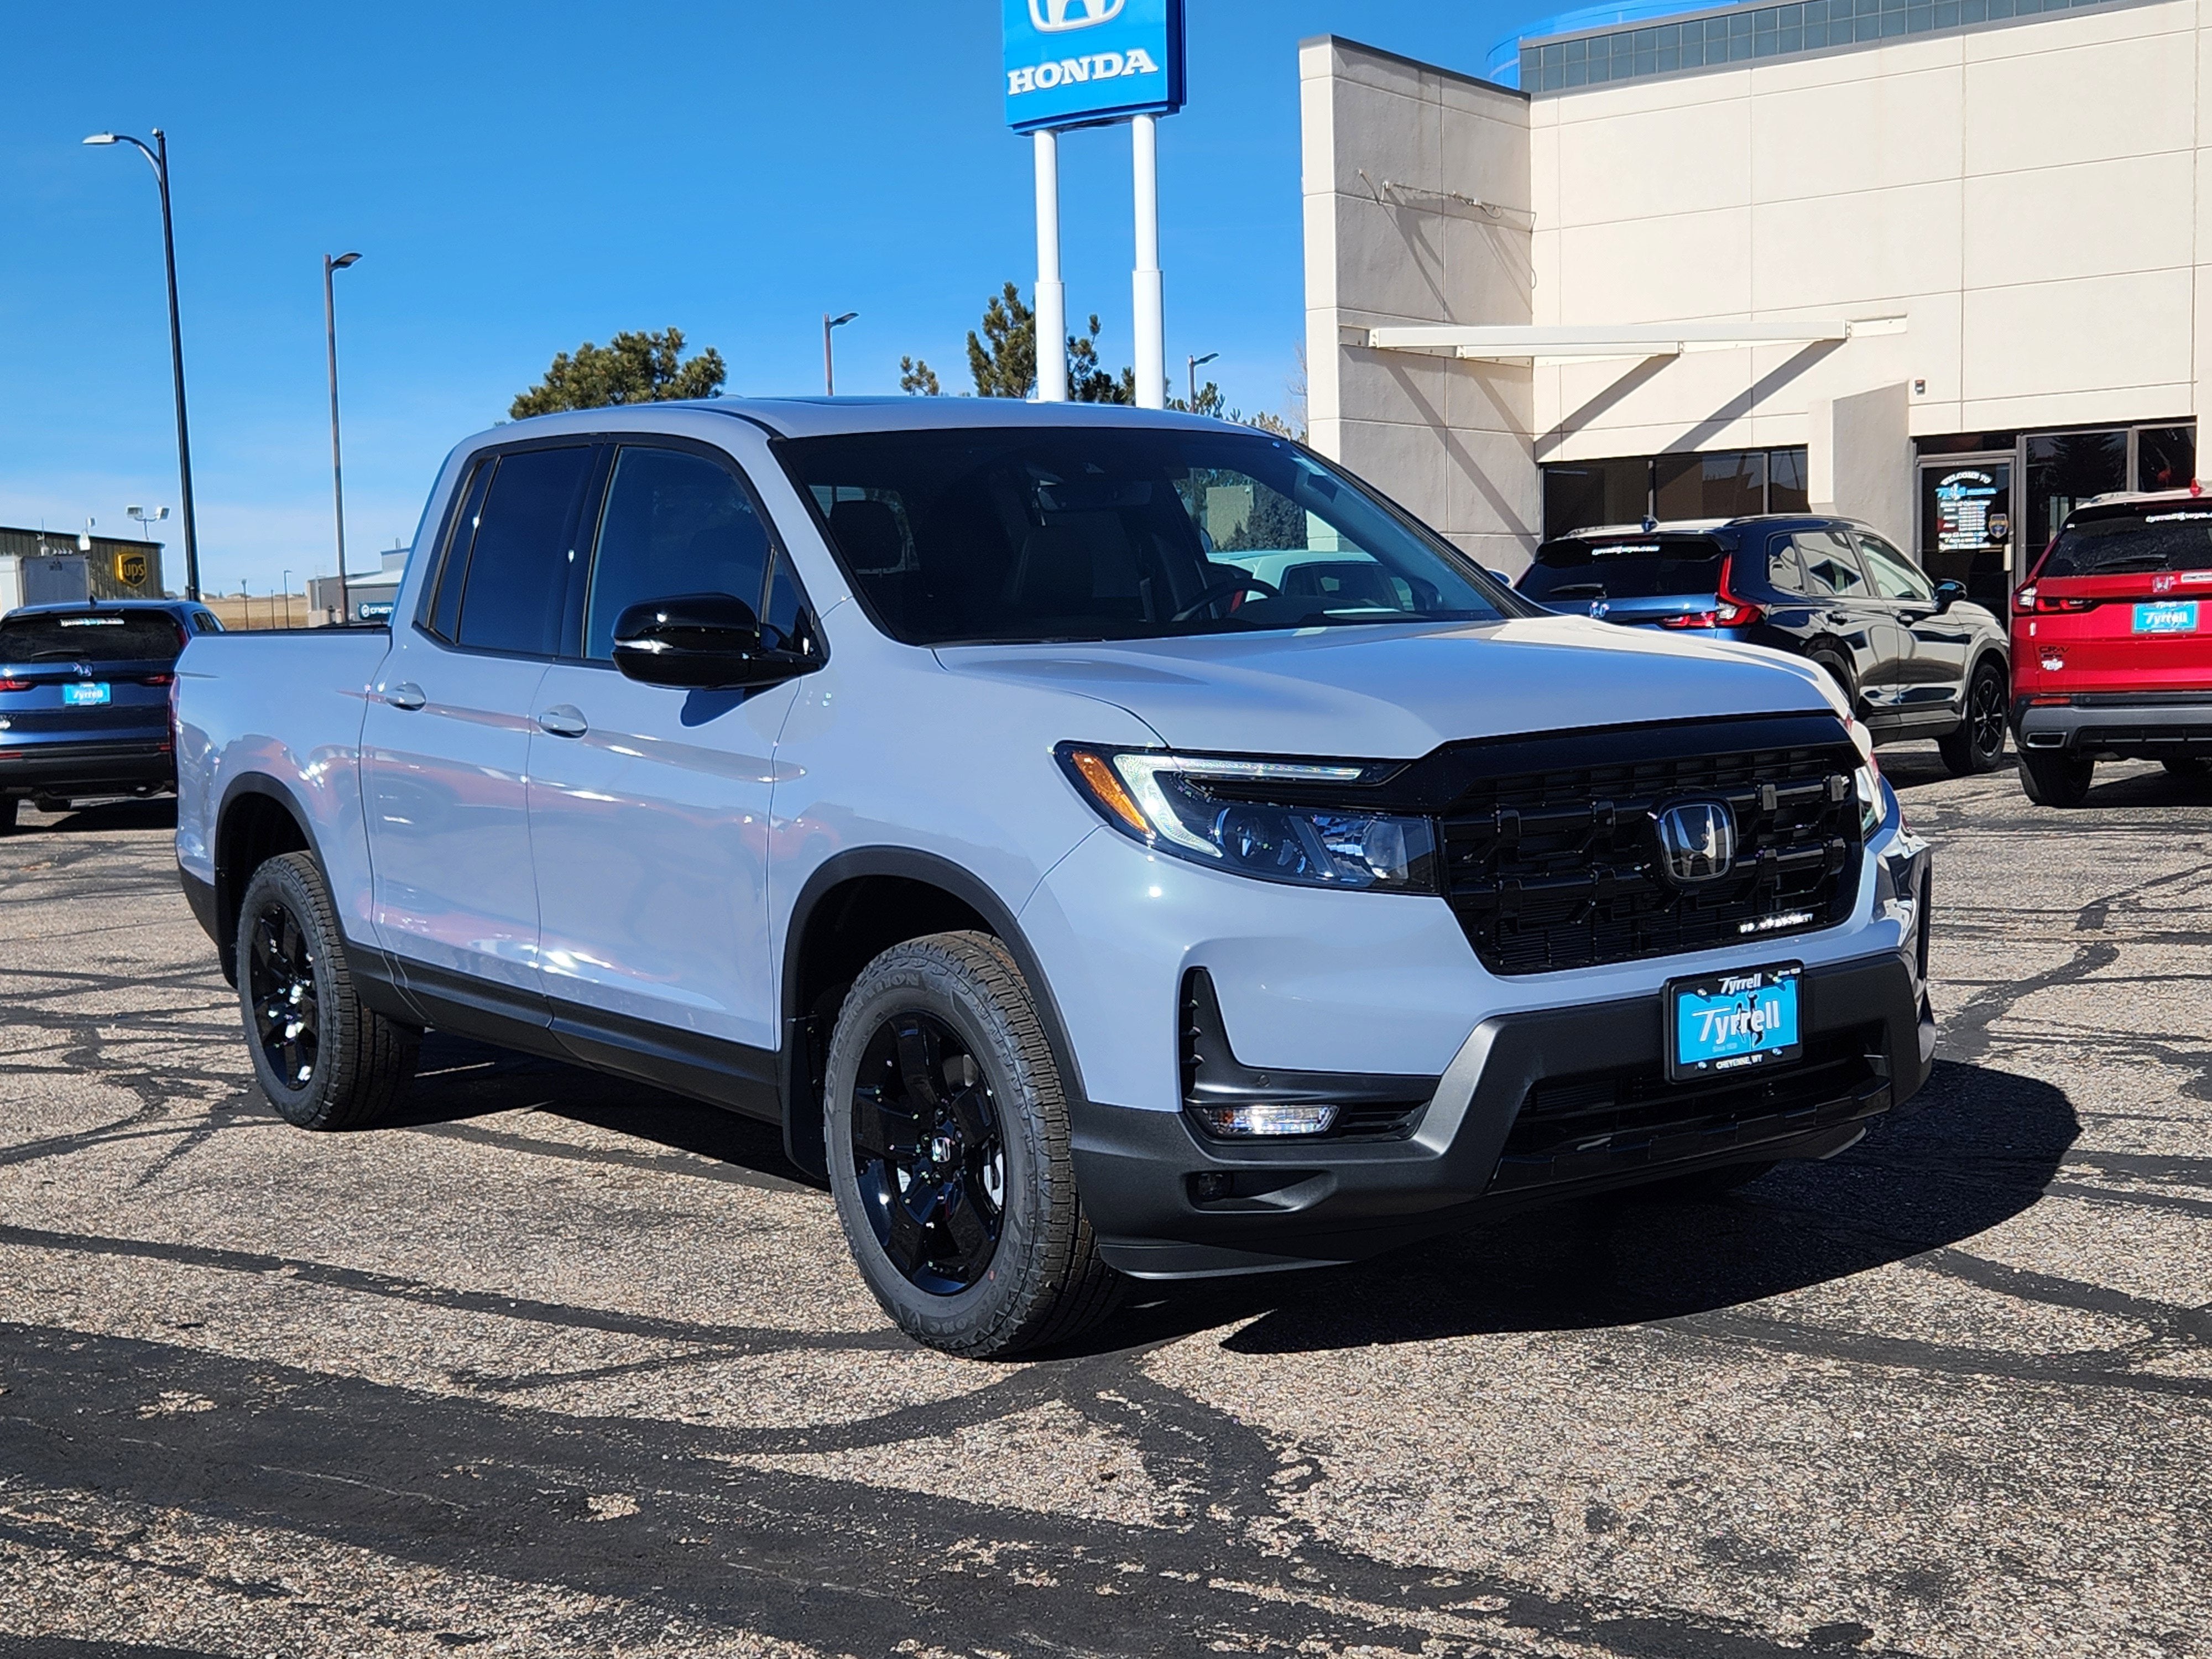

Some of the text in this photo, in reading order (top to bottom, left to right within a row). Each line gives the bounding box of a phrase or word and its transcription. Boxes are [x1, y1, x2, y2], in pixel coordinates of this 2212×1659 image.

[1008, 49, 1158, 95] HONDA
[1939, 471, 1993, 486] WELCOME TO
[2142, 611, 2188, 625] Tyrrell
[1718, 972, 1762, 994] Tyrrell
[1692, 1000, 1780, 1045] Tyrrell
